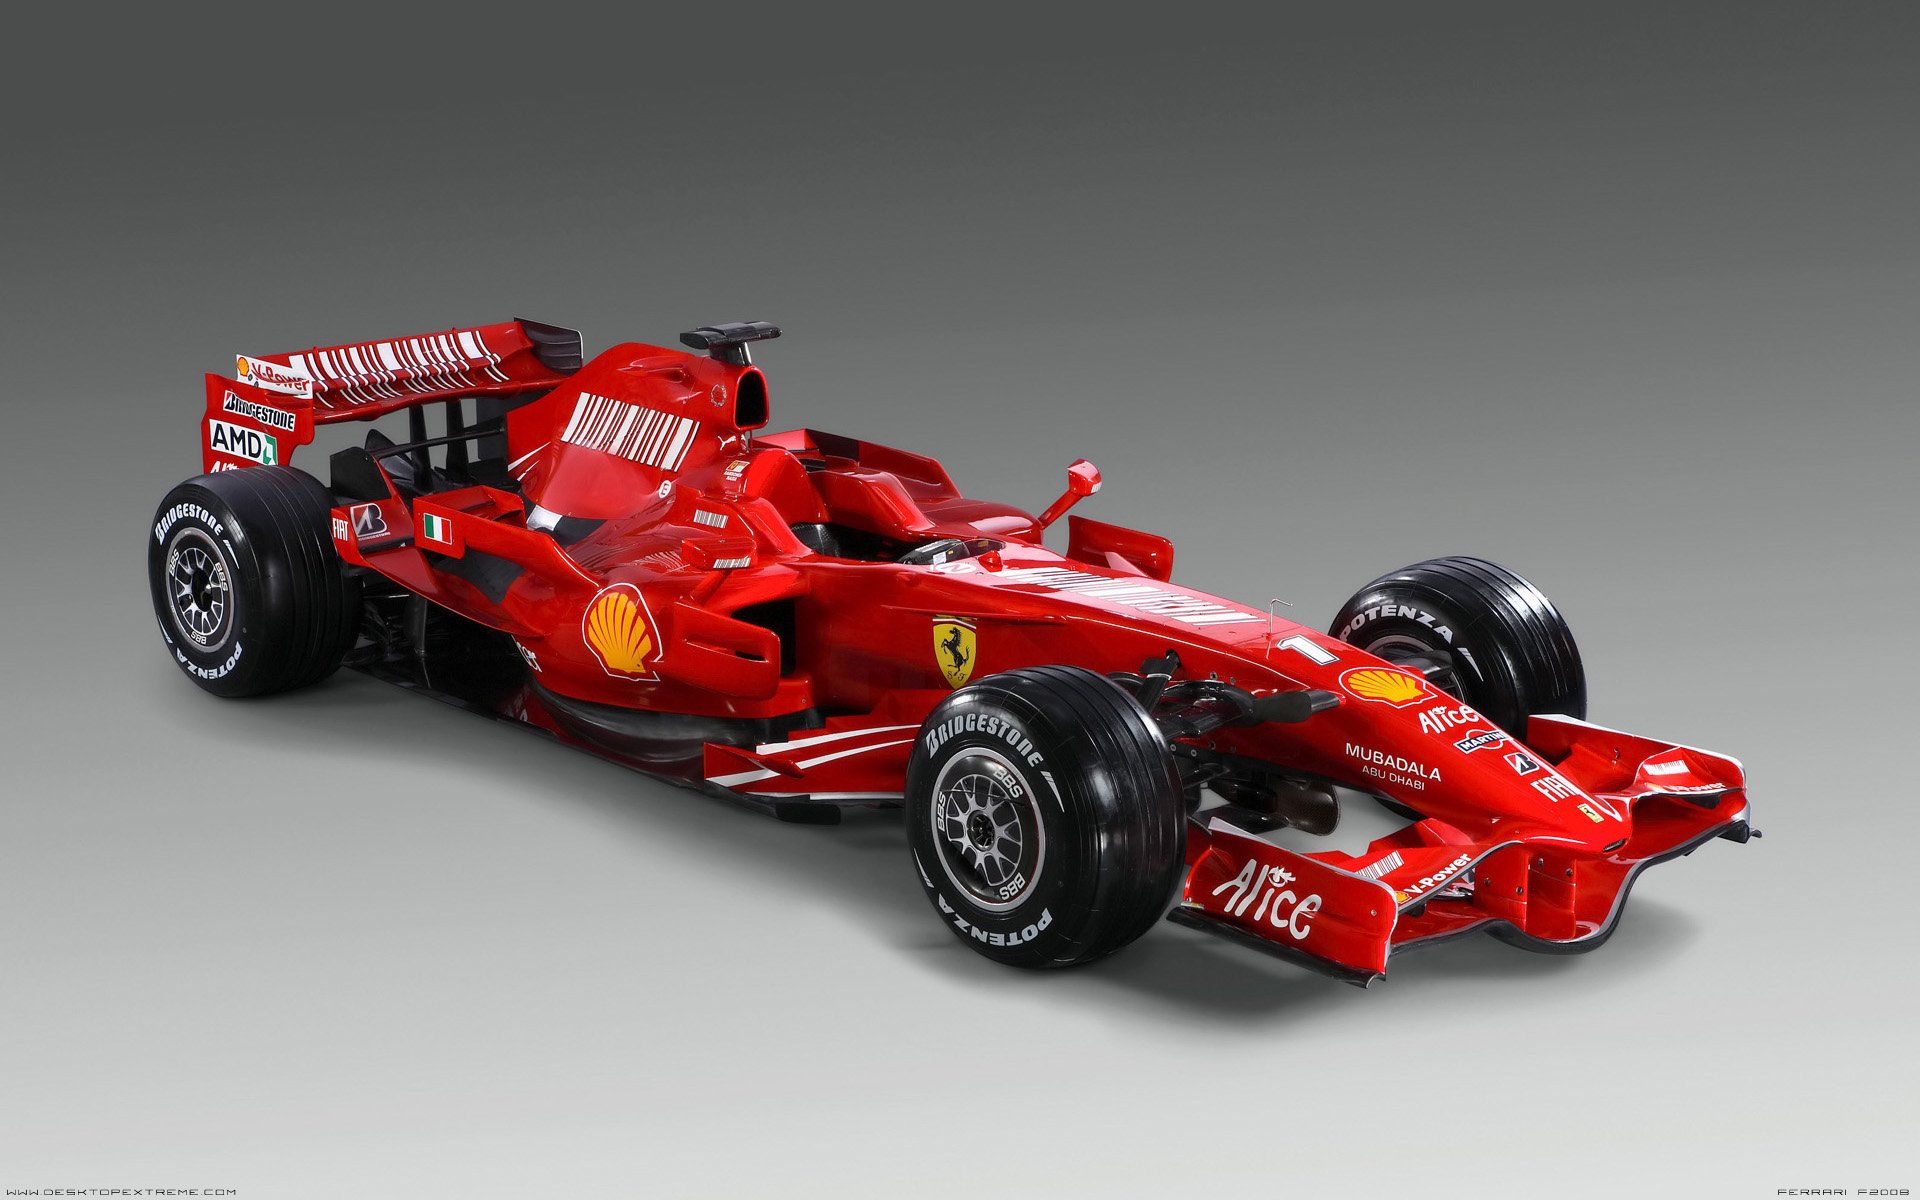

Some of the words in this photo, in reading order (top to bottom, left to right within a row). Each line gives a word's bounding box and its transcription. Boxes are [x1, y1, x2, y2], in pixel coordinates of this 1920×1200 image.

[251, 363, 310, 391] V-Power
[225, 392, 295, 430] BRIDGESTONE
[212, 423, 262, 459] AMD
[155, 503, 224, 546] BRIDGESTONE
[332, 517, 349, 542] FIAT
[169, 549, 179, 577] BBS
[214, 562, 228, 592] BBS
[191, 631, 207, 645] BBS
[1339, 604, 1454, 644] POTENZA
[177, 641, 243, 680] POTENZA
[1275, 634, 1341, 666] 1
[1418, 703, 1480, 735] Alice
[925, 713, 1044, 768] BRIDGESTONE
[1345, 742, 1442, 782] MUBADALA
[1362, 764, 1386, 780] ABU
[1389, 774, 1425, 791] DHABI
[993, 765, 1024, 799] BBS
[937, 790, 947, 833] BBS
[1000, 872, 1026, 901] BBS
[1403, 853, 1473, 893] V-Power
[1212, 858, 1322, 940] Alice
[938, 893, 1053, 947] POTENZA
